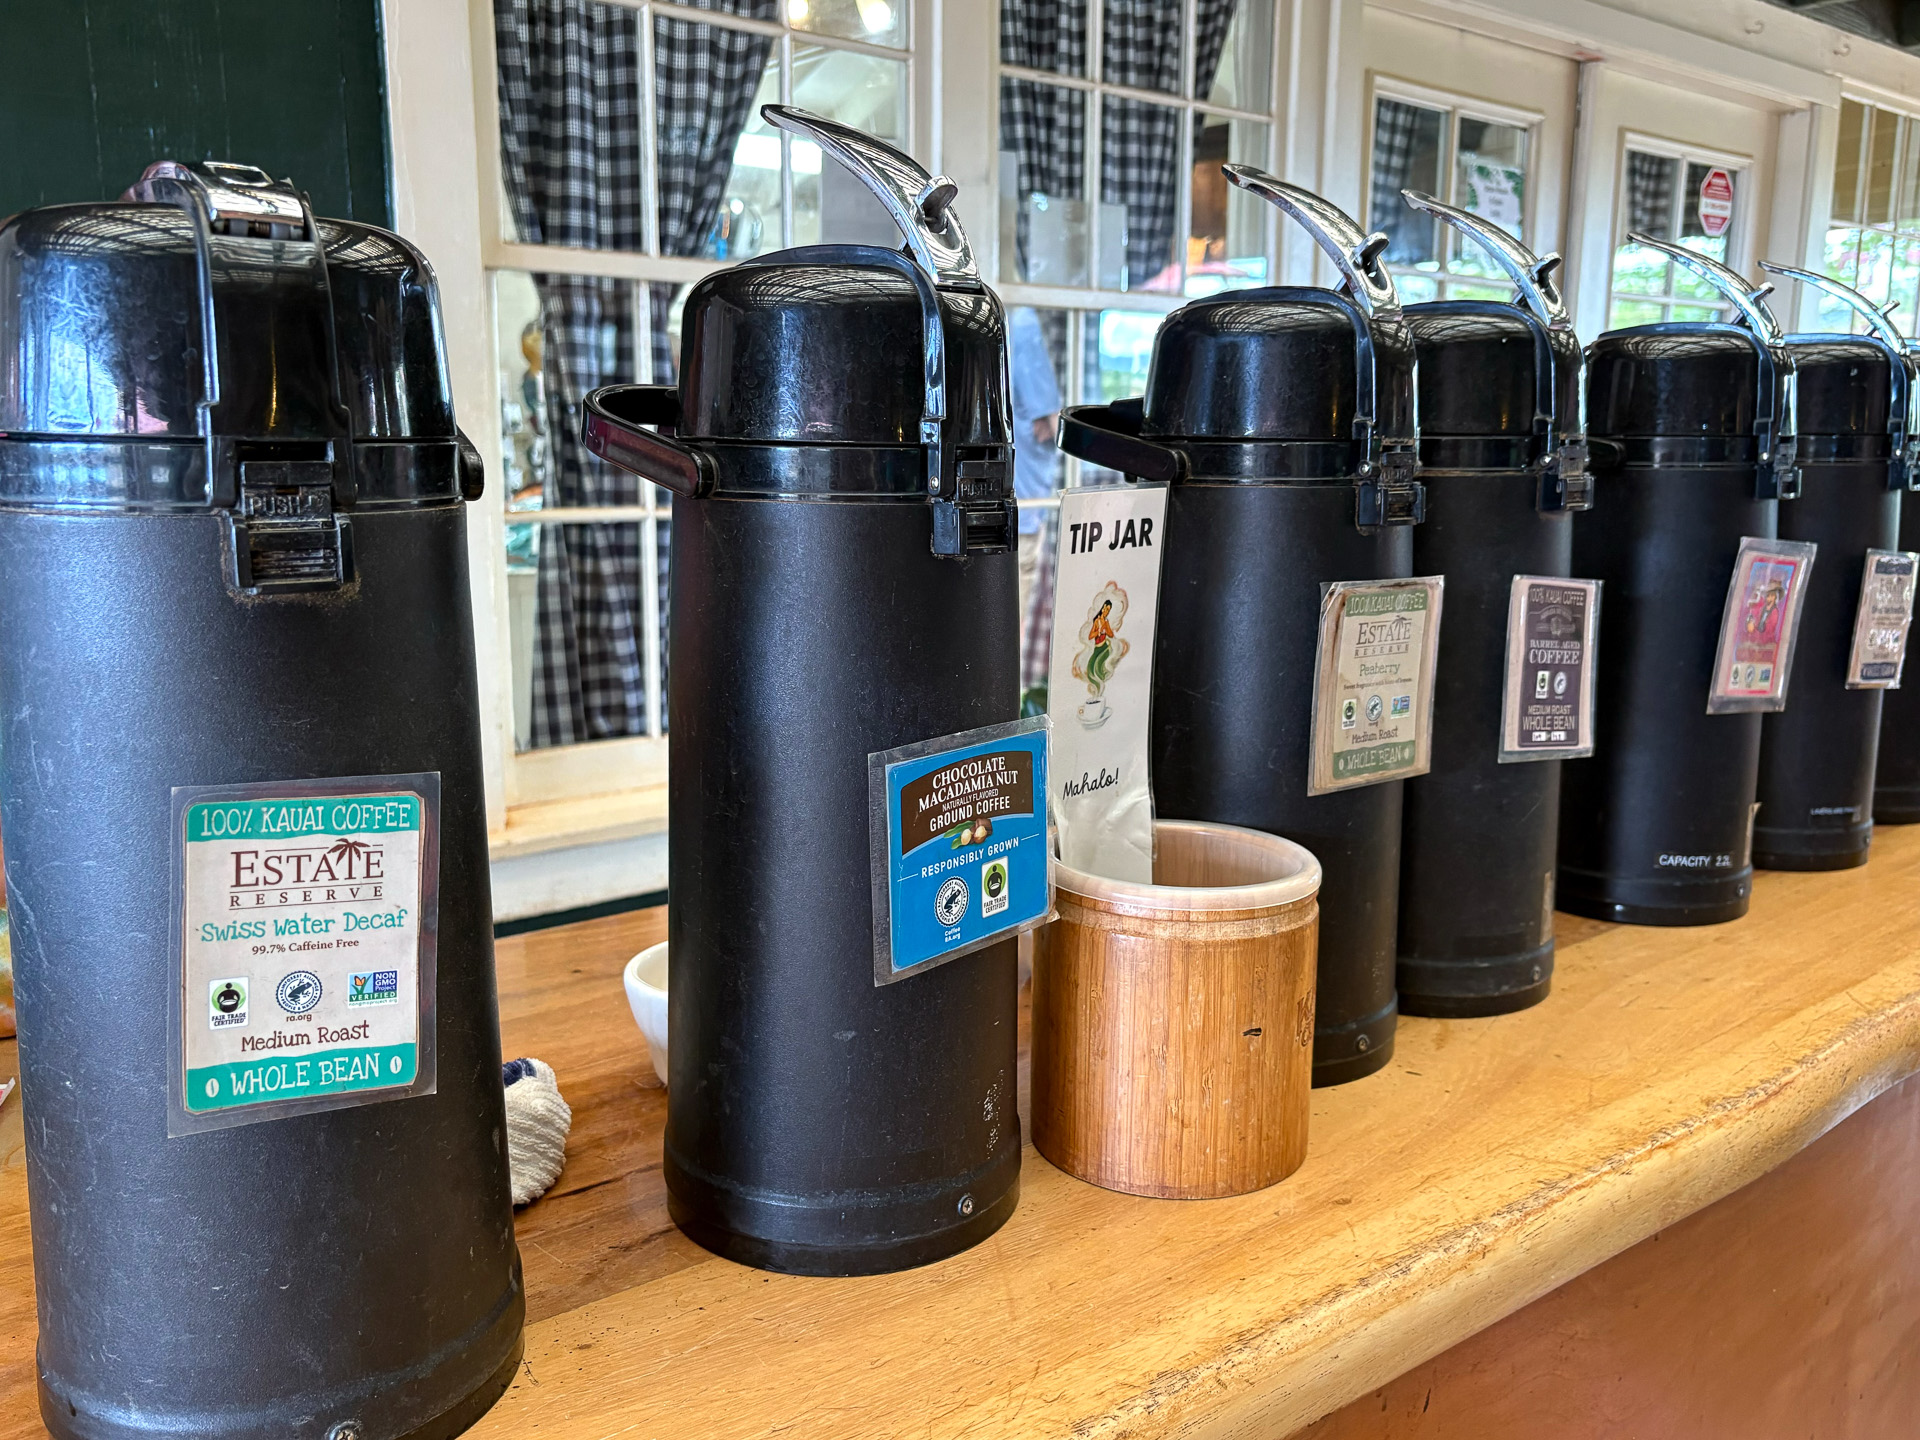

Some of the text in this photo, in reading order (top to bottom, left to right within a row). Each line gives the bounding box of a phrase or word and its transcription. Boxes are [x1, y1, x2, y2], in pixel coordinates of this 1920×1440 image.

[249, 496, 300, 515] PUSH
[1070, 518, 1153, 554] TIP JAR
[1395, 592, 1425, 610] COFFEE
[1354, 643, 1410, 657] RESERVE
[1530, 639, 1581, 650] BARREL AGED
[1529, 648, 1580, 665] COFFEE
[1359, 662, 1401, 677] Peaberry
[1527, 704, 1572, 715] MEDIUM ROAST
[1522, 715, 1575, 730] WHOLE BEAN
[1379, 726, 1399, 740] Roast
[1347, 745, 1402, 770] WHOLE BEAN
[932, 756, 1006, 789] CHOCOLATE
[918, 770, 1019, 813] MACADAMIA NUT
[1063, 768, 1119, 800] Mahalo!
[942, 788, 999, 812] NATURALLY FLAVORED
[201, 802, 411, 836] 100% KAUAI COFFEE
[929, 796, 1010, 832] GROUND COFFEE
[230, 839, 384, 888] ESTATE
[921, 837, 1019, 878] RESPONSIBLY GROWN
[1659, 854, 1711, 867] CAPACITY
[230, 886, 383, 907] RESERVE
[994, 895, 1007, 904] TRADE
[985, 901, 1006, 914] CERTIFIED
[201, 909, 408, 942] Swiss Water Decaf
[944, 927, 961, 936] Coffee
[252, 938, 359, 955] 99.7% Caffeine Free
[375, 972, 396, 980] NON
[351, 991, 396, 1001] VERIFIED
[214, 1018, 245, 1027] CERTIFIED
[228, 1012, 246, 1020] TRADE
[286, 1013, 313, 1022] ra.org
[241, 1021, 370, 1052] Medium Roast
[231, 1053, 381, 1095] WHOLE BEAN
